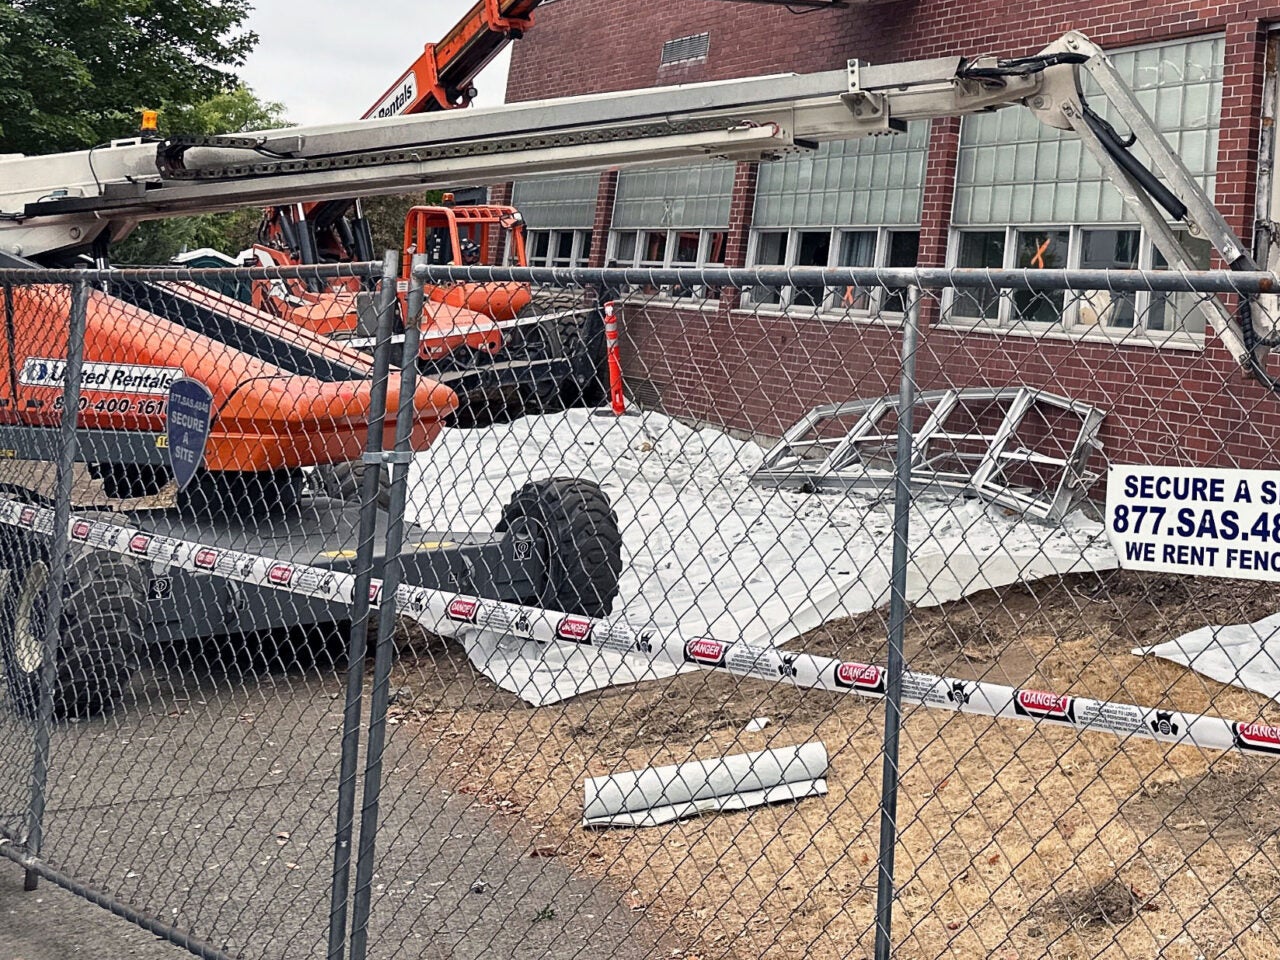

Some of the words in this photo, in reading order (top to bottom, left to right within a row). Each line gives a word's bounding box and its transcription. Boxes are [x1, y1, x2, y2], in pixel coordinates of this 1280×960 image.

[51, 368, 106, 385] Uted
[110, 370, 173, 390] Rentals
[53, 396, 168, 415] 80-400-161
[171, 410, 205, 433] SECURE
[182, 431, 189, 445] A
[175, 445, 194, 464] SITE
[1124, 474, 1225, 502] SECURE
[1233, 479, 1252, 503] A
[1125, 541, 1156, 562] WE
[1162, 544, 1219, 567] RENT
[841, 665, 877, 681] DANGER
